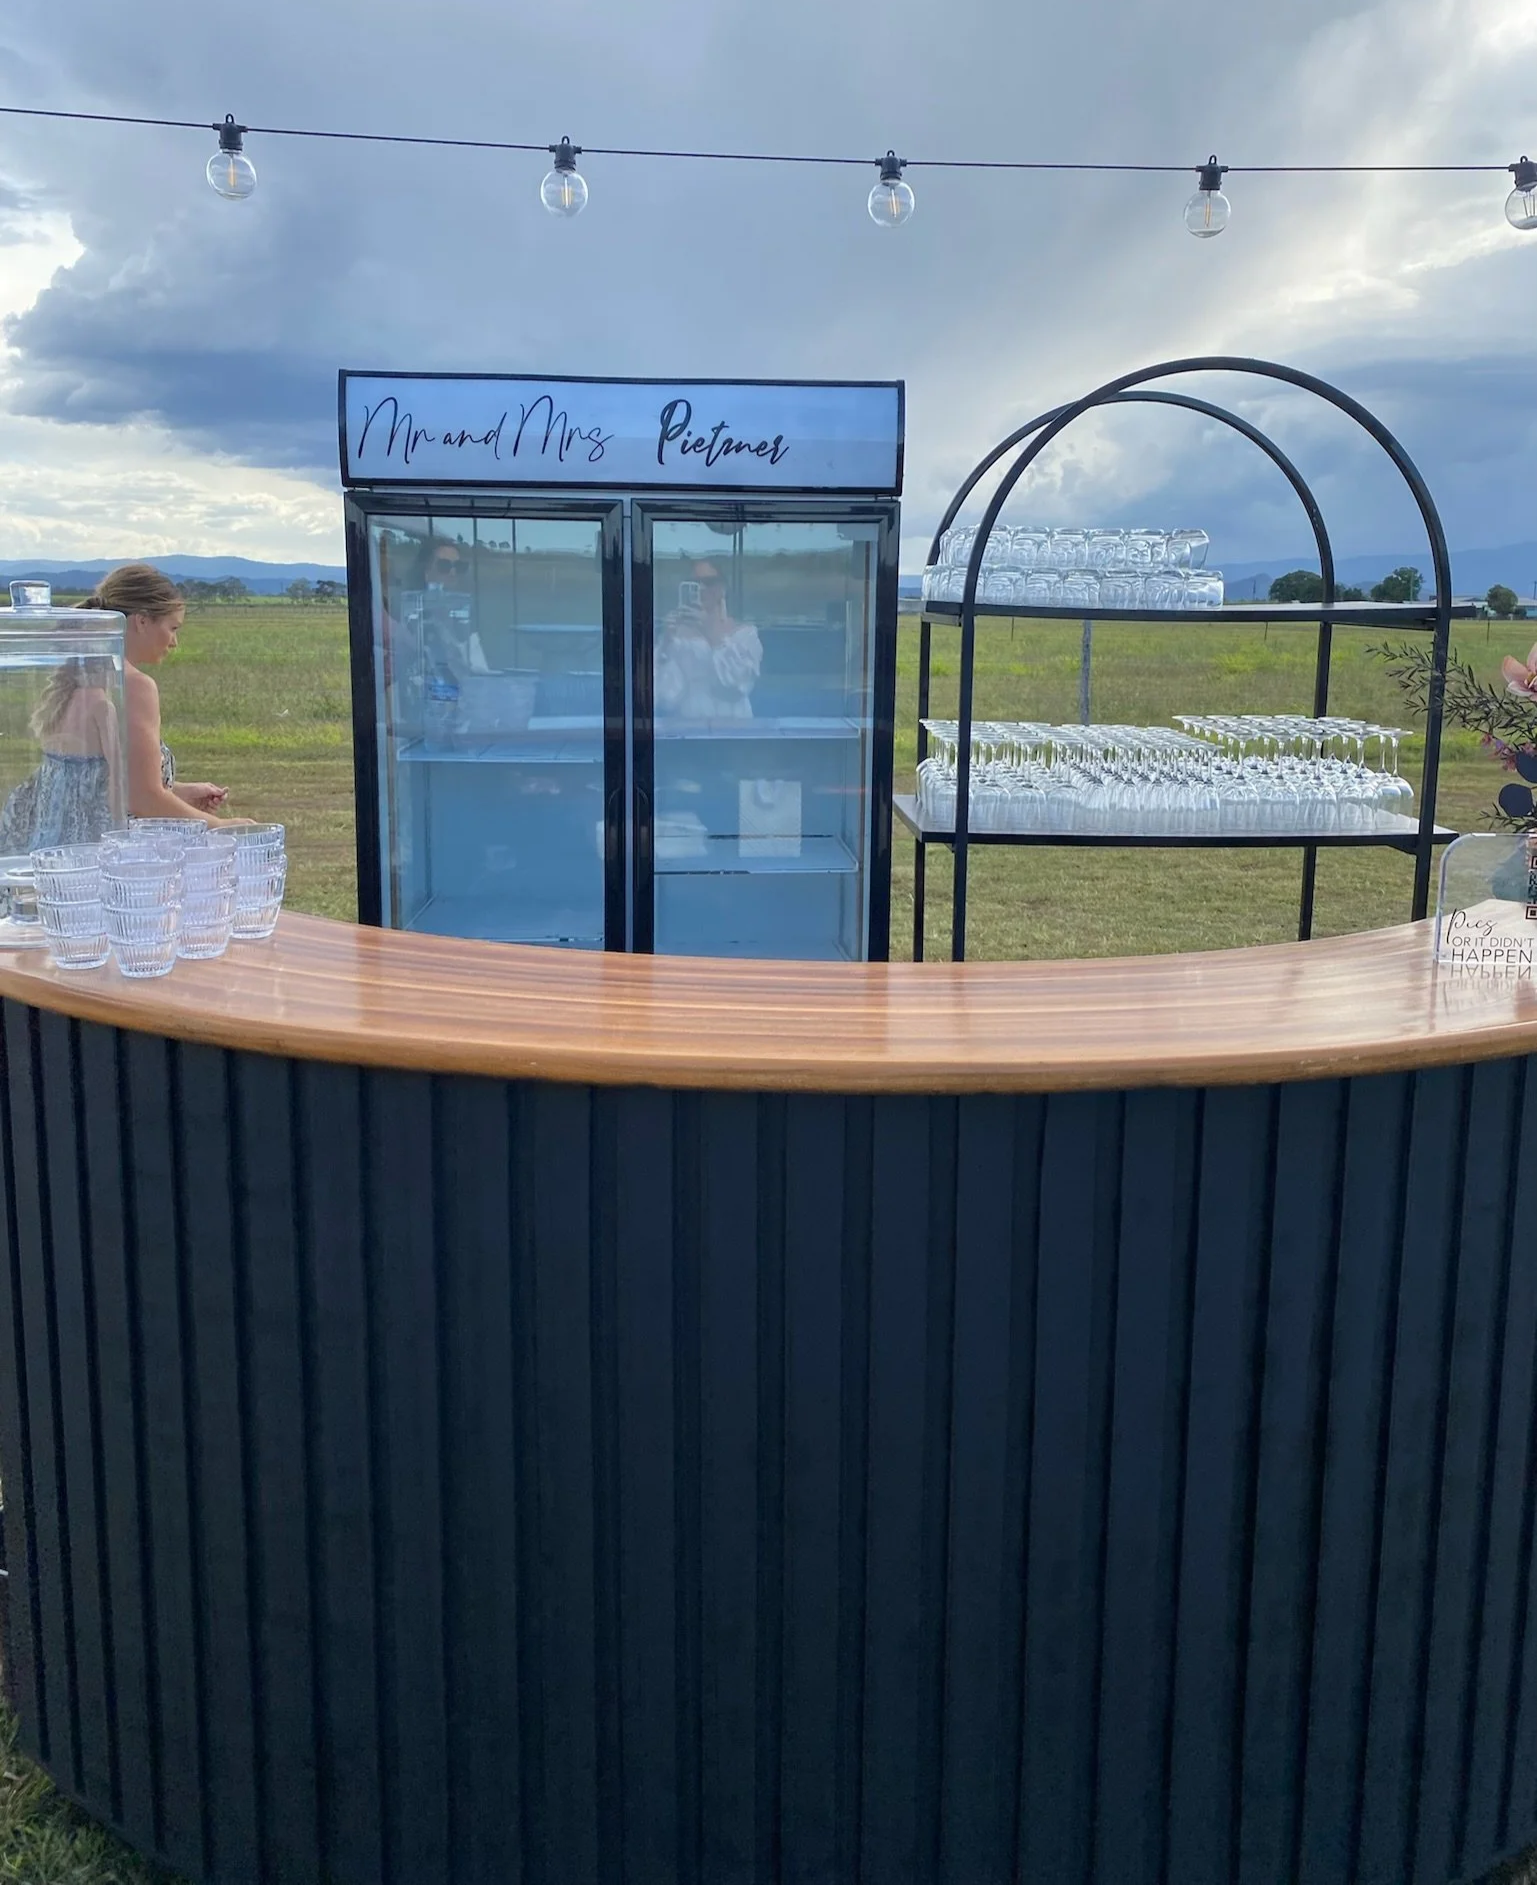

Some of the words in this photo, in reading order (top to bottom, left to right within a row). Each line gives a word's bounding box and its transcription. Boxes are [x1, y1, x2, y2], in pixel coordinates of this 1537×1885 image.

[358, 396, 435, 464] Mr
[443, 412, 507, 460] and
[513, 395, 615, 462] Mrs
[1446, 907, 1498, 945] Pics
[1452, 936, 1471, 947] OR
[1475, 936, 1485, 947] IT
[1489, 937, 1535, 948] DIDN'T
[1451, 948, 1533, 963] HAPPEN
